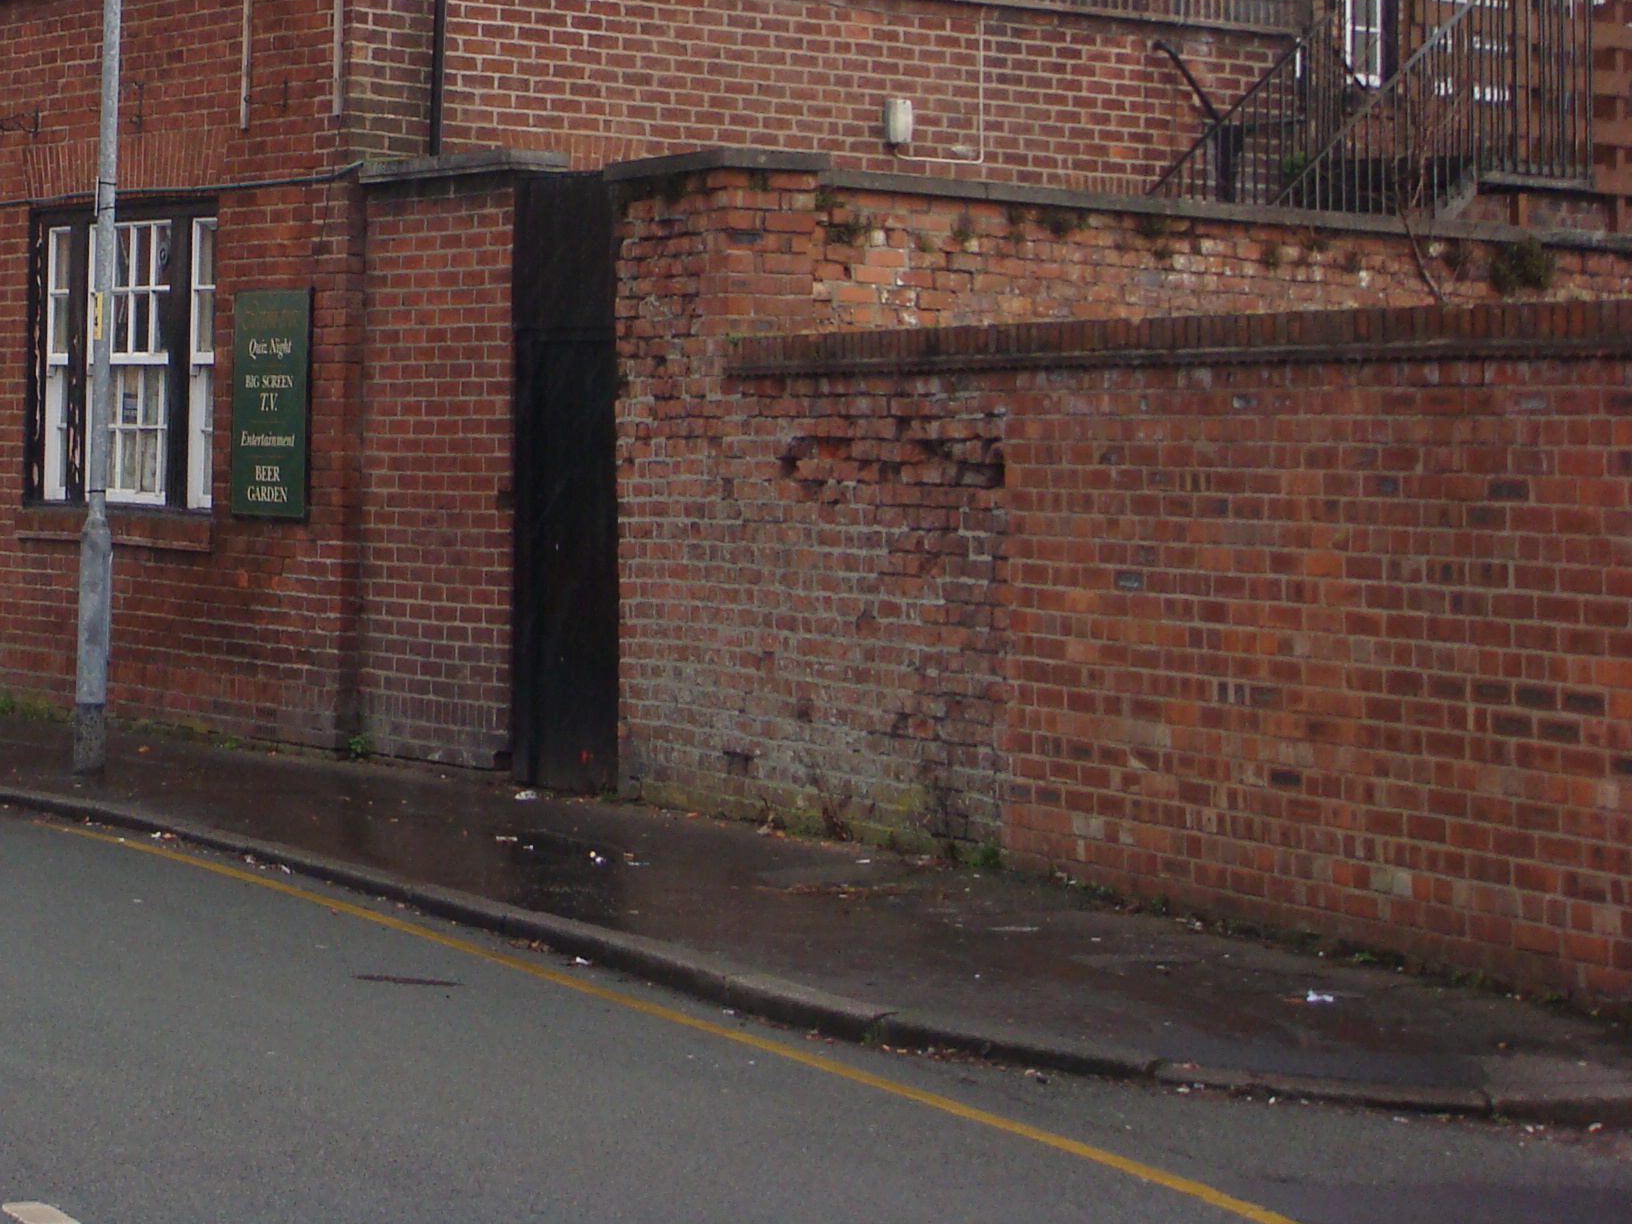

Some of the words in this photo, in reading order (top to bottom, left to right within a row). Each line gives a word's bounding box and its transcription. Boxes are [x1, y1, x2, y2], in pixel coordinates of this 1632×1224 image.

[249, 338, 268, 359] Quiz
[269, 338, 292, 360] Night
[245, 375, 260, 389] BIG
[262, 375, 293, 389] SCREEN
[260, 393, 278, 412] T.V.
[241, 431, 295, 448] Entertainment
[255, 466, 280, 482] BEER
[247, 486, 288, 503] GARDEN
